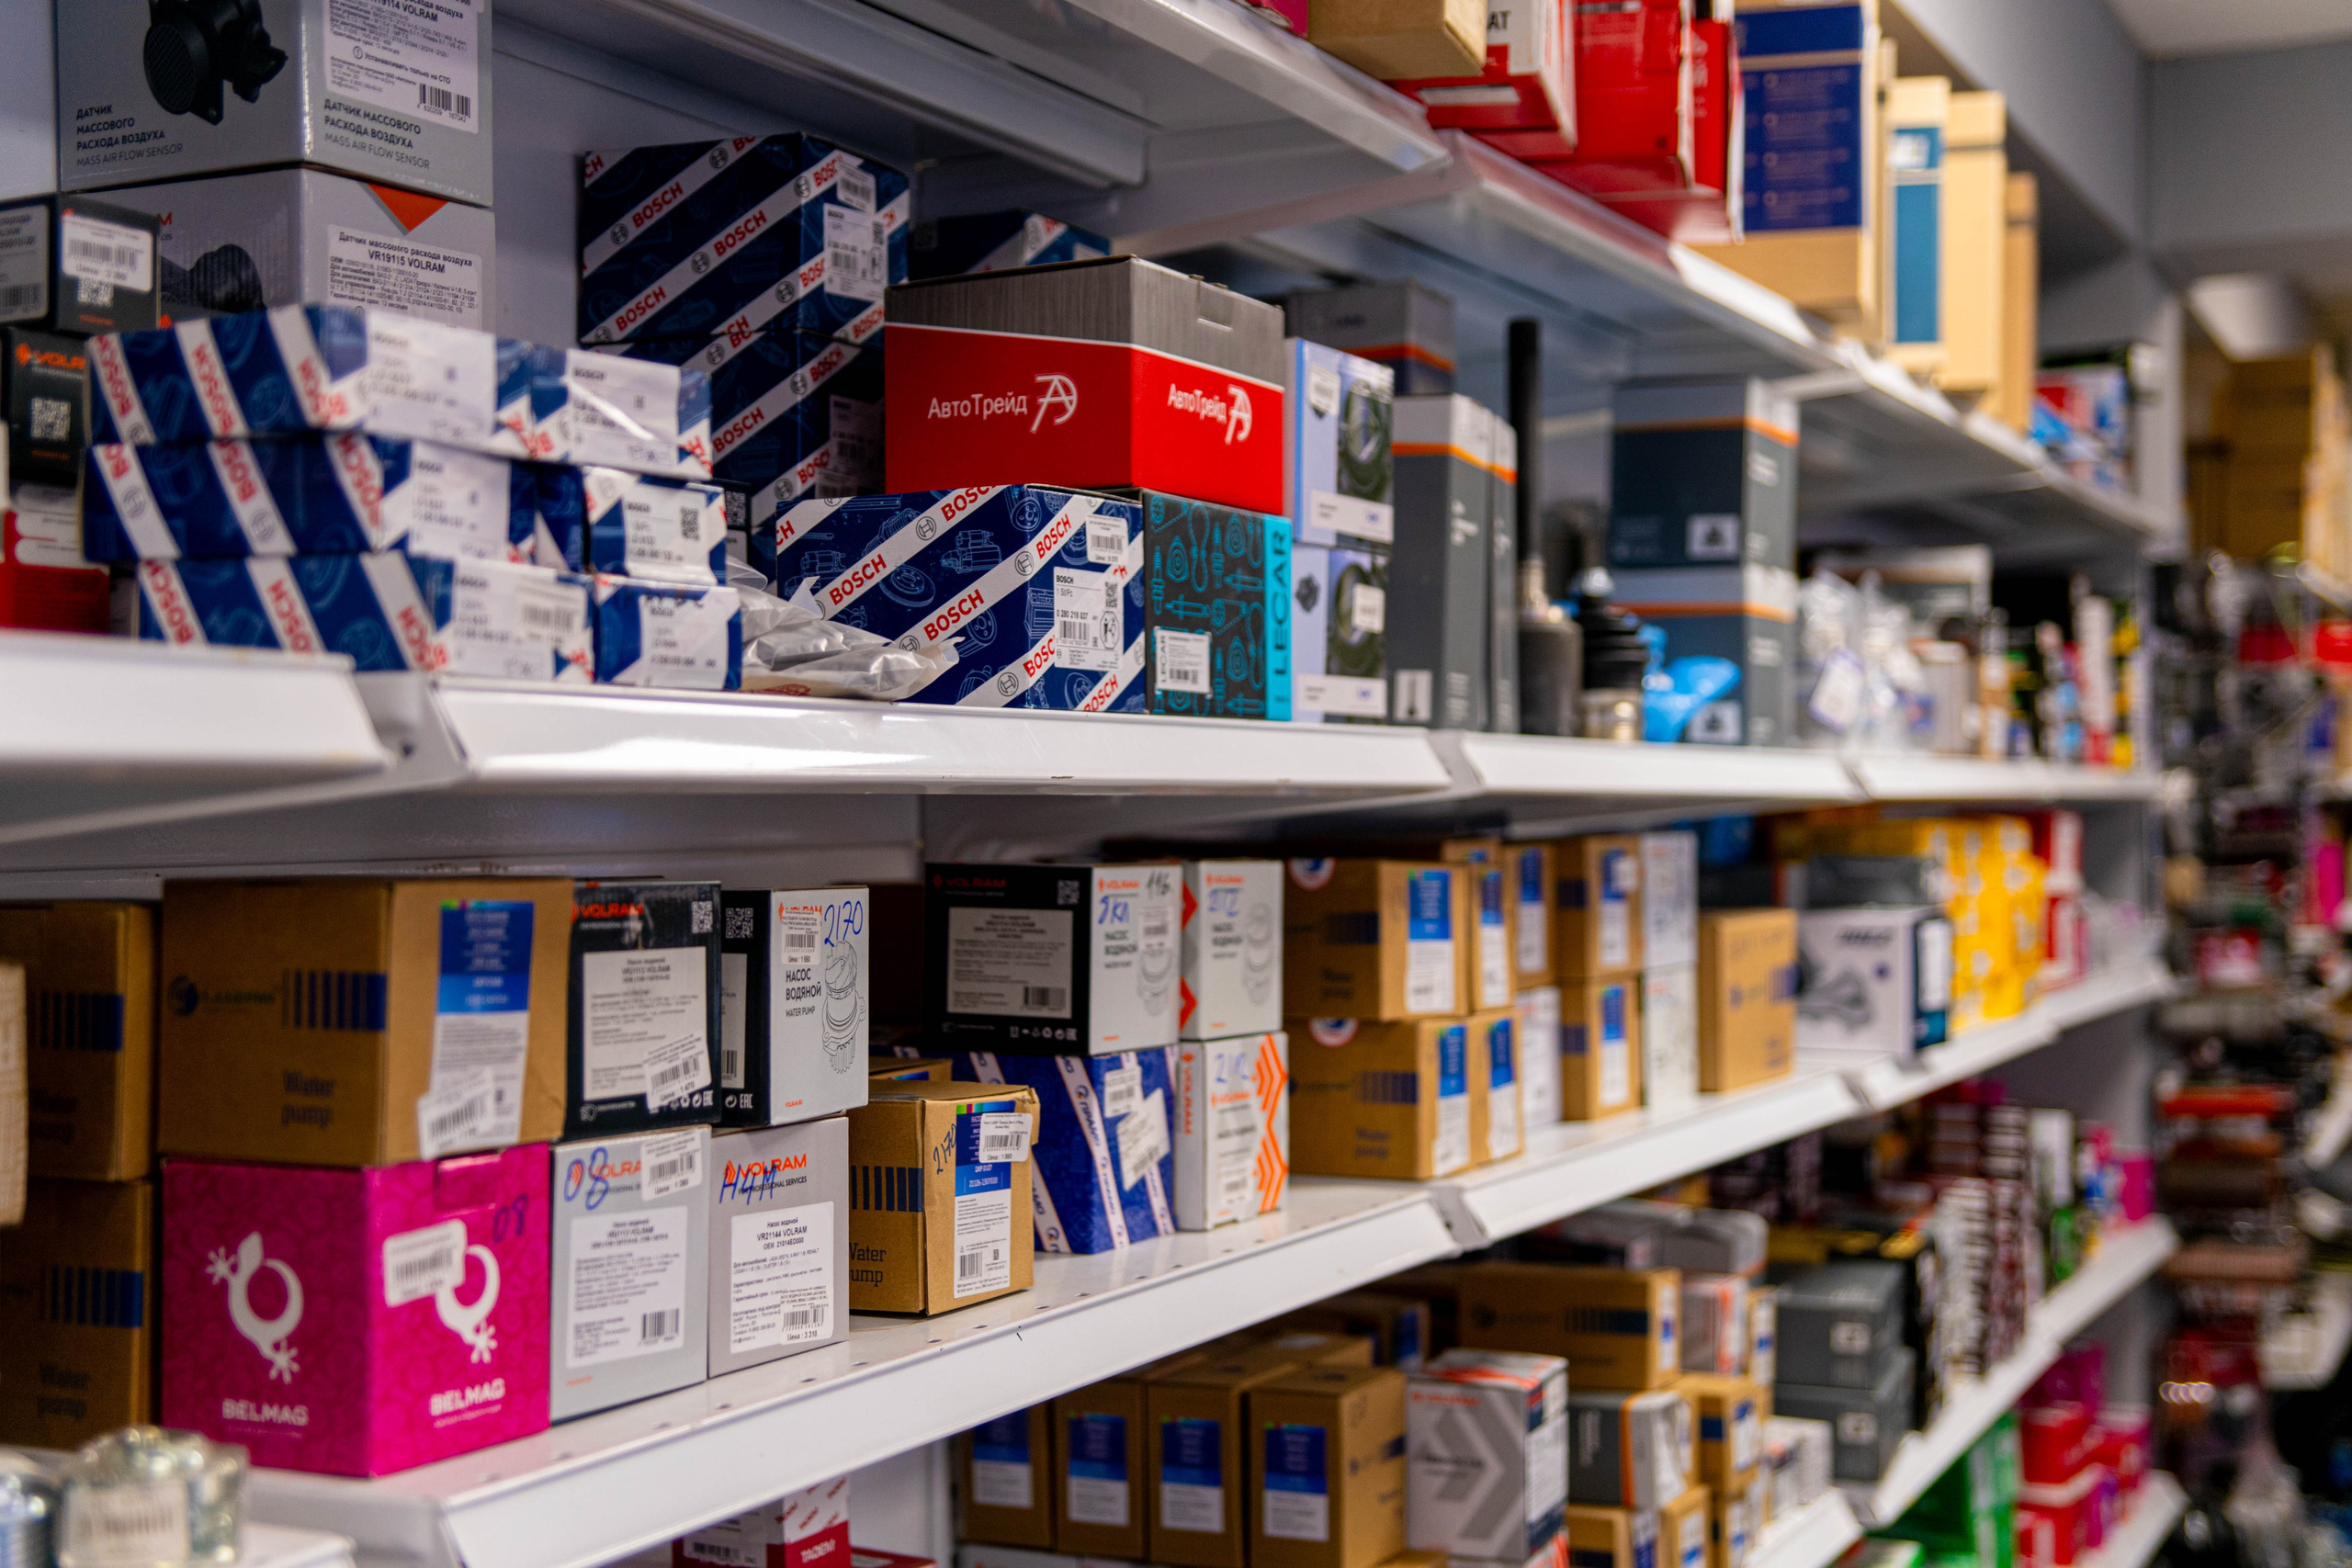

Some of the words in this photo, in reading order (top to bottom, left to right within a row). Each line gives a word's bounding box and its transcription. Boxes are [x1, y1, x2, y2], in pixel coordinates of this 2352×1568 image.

[401, 3, 438, 22] VOLRAM
[435, 4, 464, 19] воздуха
[438, 74, 451, 85] СТО
[76, 105, 113, 120] ДАТЧИК
[76, 118, 135, 135] МАССОВОГО
[324, 99, 362, 119] ДАТЧИК
[363, 109, 421, 135] МАССОВОГО
[76, 137, 119, 151] РАСХОДА
[121, 130, 165, 144] ВОЗДУХА
[324, 116, 368, 137] РАСХОДА
[370, 128, 413, 149] ВОЗДУХА
[76, 153, 101, 167] MASS
[102, 152, 117, 163] AIR
[119, 149, 143, 162] FLOW
[146, 143, 184, 158] SENSOR
[324, 132, 351, 148] MASS
[352, 139, 368, 152] AIR
[368, 141, 394, 159] FLOW
[395, 151, 431, 170] SENSOR
[631, 181, 684, 230] BOSCH
[713, 209, 768, 258] BOSCH
[339, 231, 367, 246] Датчик
[368, 240, 409, 254] массового
[411, 247, 441, 261] расхода
[442, 254, 473, 267] воздуха
[368, 249, 406, 266] VR19115
[407, 258, 446, 274] VOLRAM
[615, 286, 667, 333] BOSCH
[809, 345, 844, 383] BOSCH
[928, 391, 1028, 420] АвтоТрейд
[1168, 383, 1227, 424] АвтоТрейд
[712, 407, 765, 454] BOSCH
[797, 449, 831, 486] BOSC
[1035, 513, 1072, 560] BOSCH
[829, 554, 888, 605] BOSCH
[1057, 574, 1074, 585] BOSCH
[267, 578, 313, 654] OSCH
[923, 588, 986, 642] BOSCH
[1272, 530, 1289, 675] LECAR
[1023, 634, 1056, 678] BOSC
[945, 877, 1007, 888] VOLRAM
[580, 902, 644, 919] VOLRAM
[824, 900, 864, 948] 2170
[786, 968, 811, 983] НАСОС
[786, 981, 822, 1002] ВОДЯНОЙ
[785, 1007, 803, 1018] WATER
[802, 1005, 816, 1015] PUMP
[740, 1093, 754, 1109] EAC
[933, 1122, 956, 1175] 2170
[563, 1145, 610, 1212] 08
[590, 1158, 641, 1181] VOLRA
[740, 1154, 808, 1179] VOLRAM
[786, 1175, 808, 1187] SERVICES
[492, 1191, 530, 1244] 08
[766, 1221, 780, 1229] Насос
[780, 1216, 798, 1226] водяной
[756, 1230, 782, 1242] VR21144
[782, 1224, 808, 1237] VOLRAM
[763, 1242, 775, 1250] OEM
[776, 1236, 805, 1248] 21014ED000
[850, 1269, 884, 1287] ump
[786, 1332, 800, 1341] Цена
[808, 1329, 818, 1338] 310
[430, 1377, 506, 1417] BELMAG
[220, 1398, 310, 1427] BELMAG
